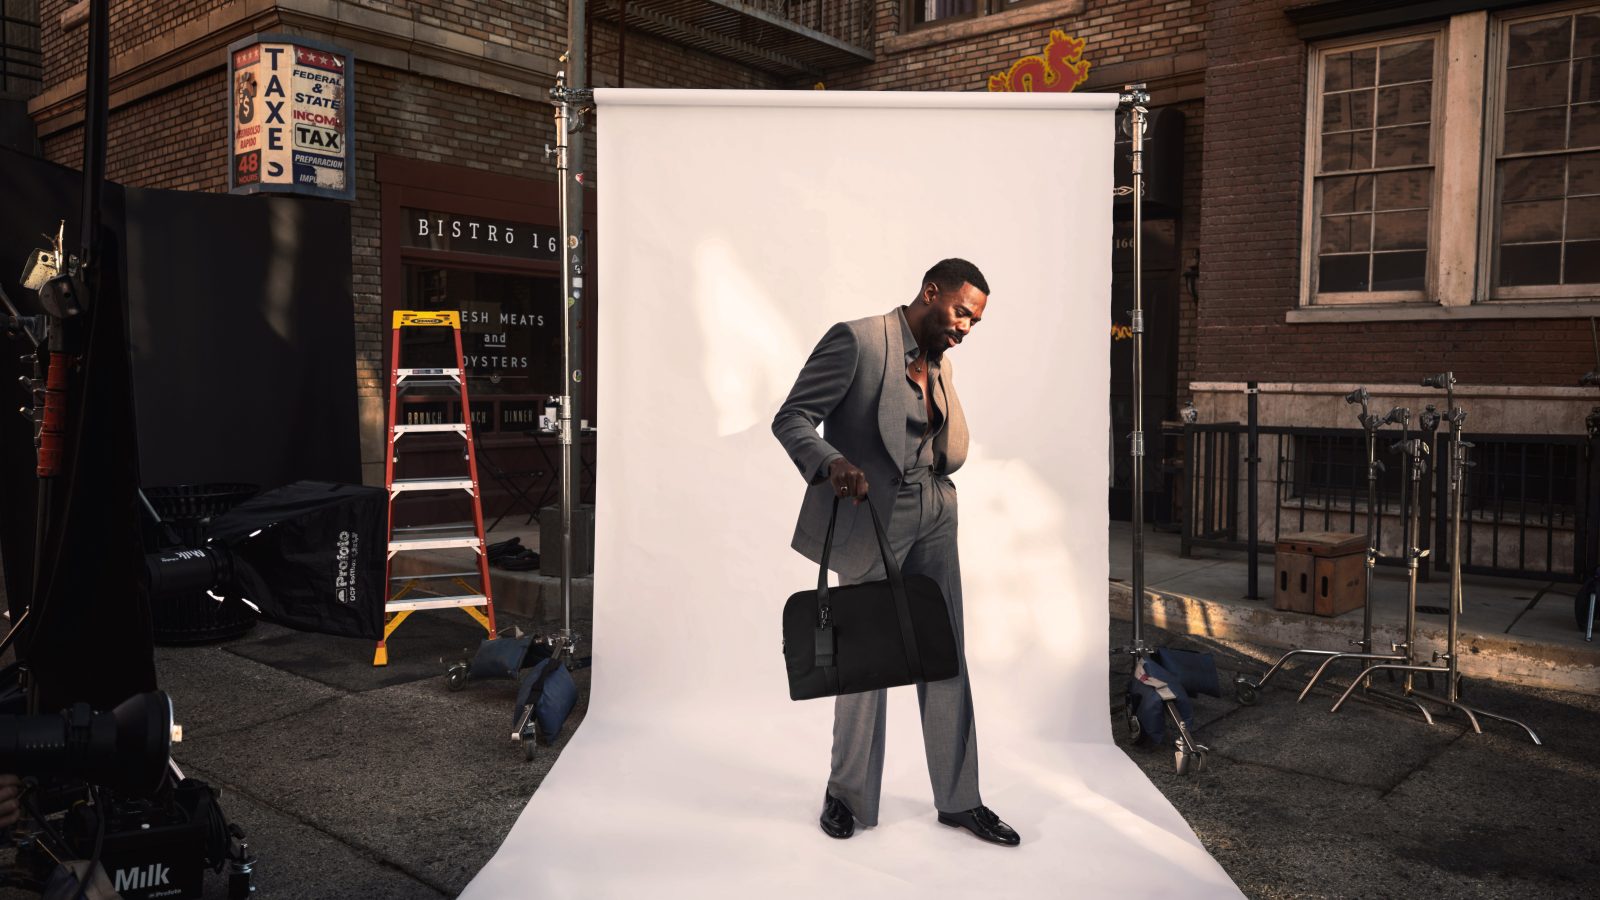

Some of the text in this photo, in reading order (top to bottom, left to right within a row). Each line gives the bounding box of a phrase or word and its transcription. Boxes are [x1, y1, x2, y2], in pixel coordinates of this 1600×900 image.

[292, 69, 342, 87] FEDERAL
[312, 83, 323, 94] &
[295, 92, 340, 110] STATE
[264, 47, 285, 177] TAXES
[297, 127, 340, 150] TAX
[239, 152, 259, 174] 48
[295, 154, 343, 169] PREPARACION
[461, 311, 544, 326] ESH MEATS
[484, 332, 506, 343] and
[460, 411, 486, 424] LNCH
[504, 409, 533, 423] DINNER
[336, 531, 349, 587] Profoto
[115, 863, 170, 892] Milk
